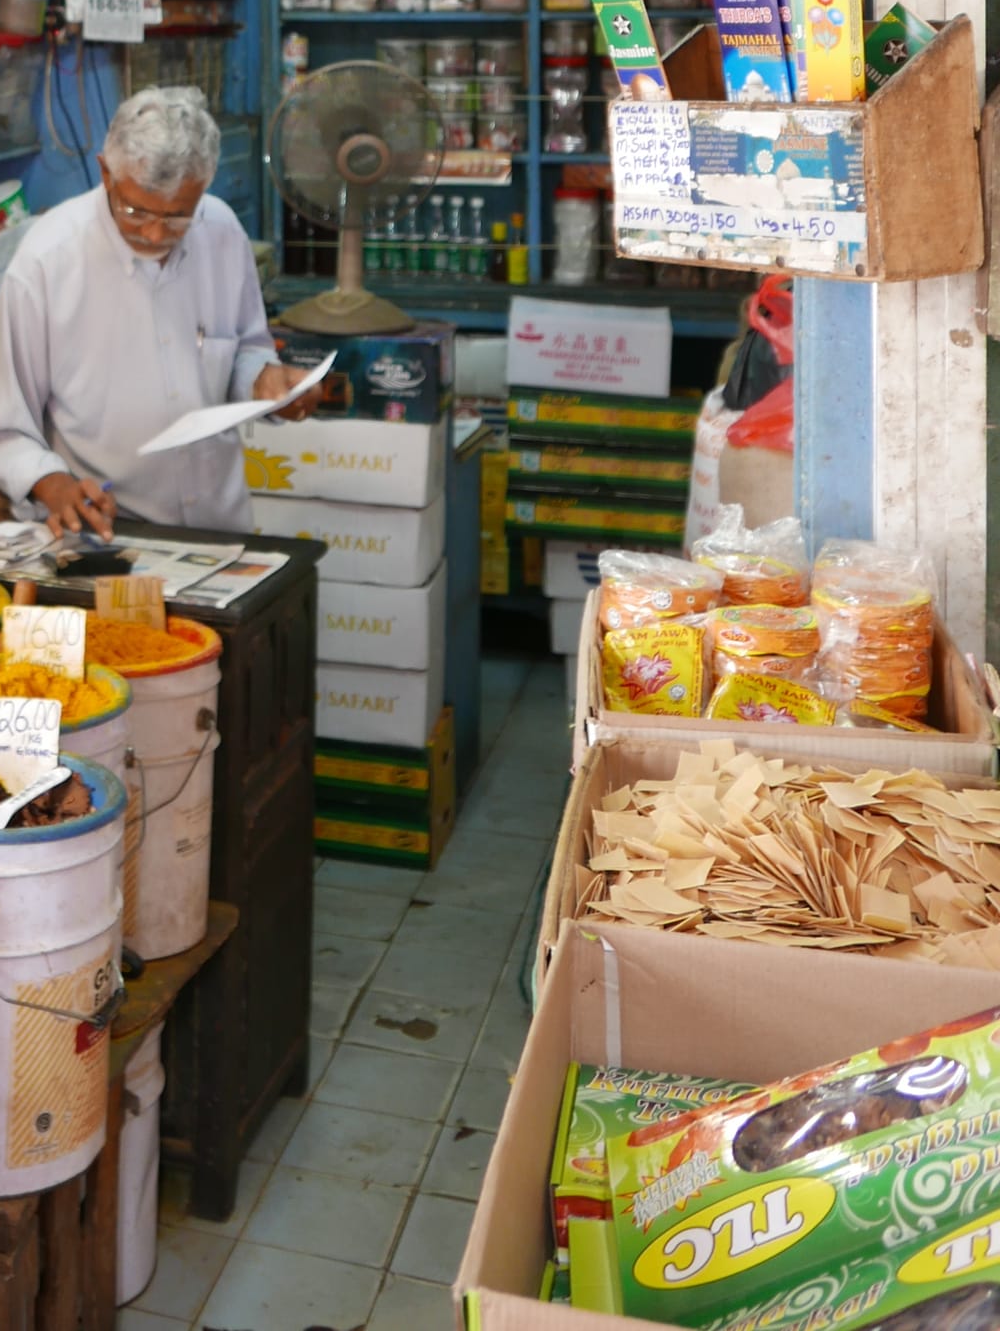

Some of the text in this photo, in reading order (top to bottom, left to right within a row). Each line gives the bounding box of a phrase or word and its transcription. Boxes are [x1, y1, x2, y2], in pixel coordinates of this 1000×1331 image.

[721, 34, 781, 47] TAJMAHAL
[608, 44, 657, 60] Jasmine
[623, 208, 663, 222] ASSAM
[327, 452, 393, 472] SAFARI
[327, 614, 393, 636] SAFARI
[327, 691, 396, 714] SAFARI
[587, 1069, 732, 1102] Kurma
[664, 1186, 804, 1283] TLC
